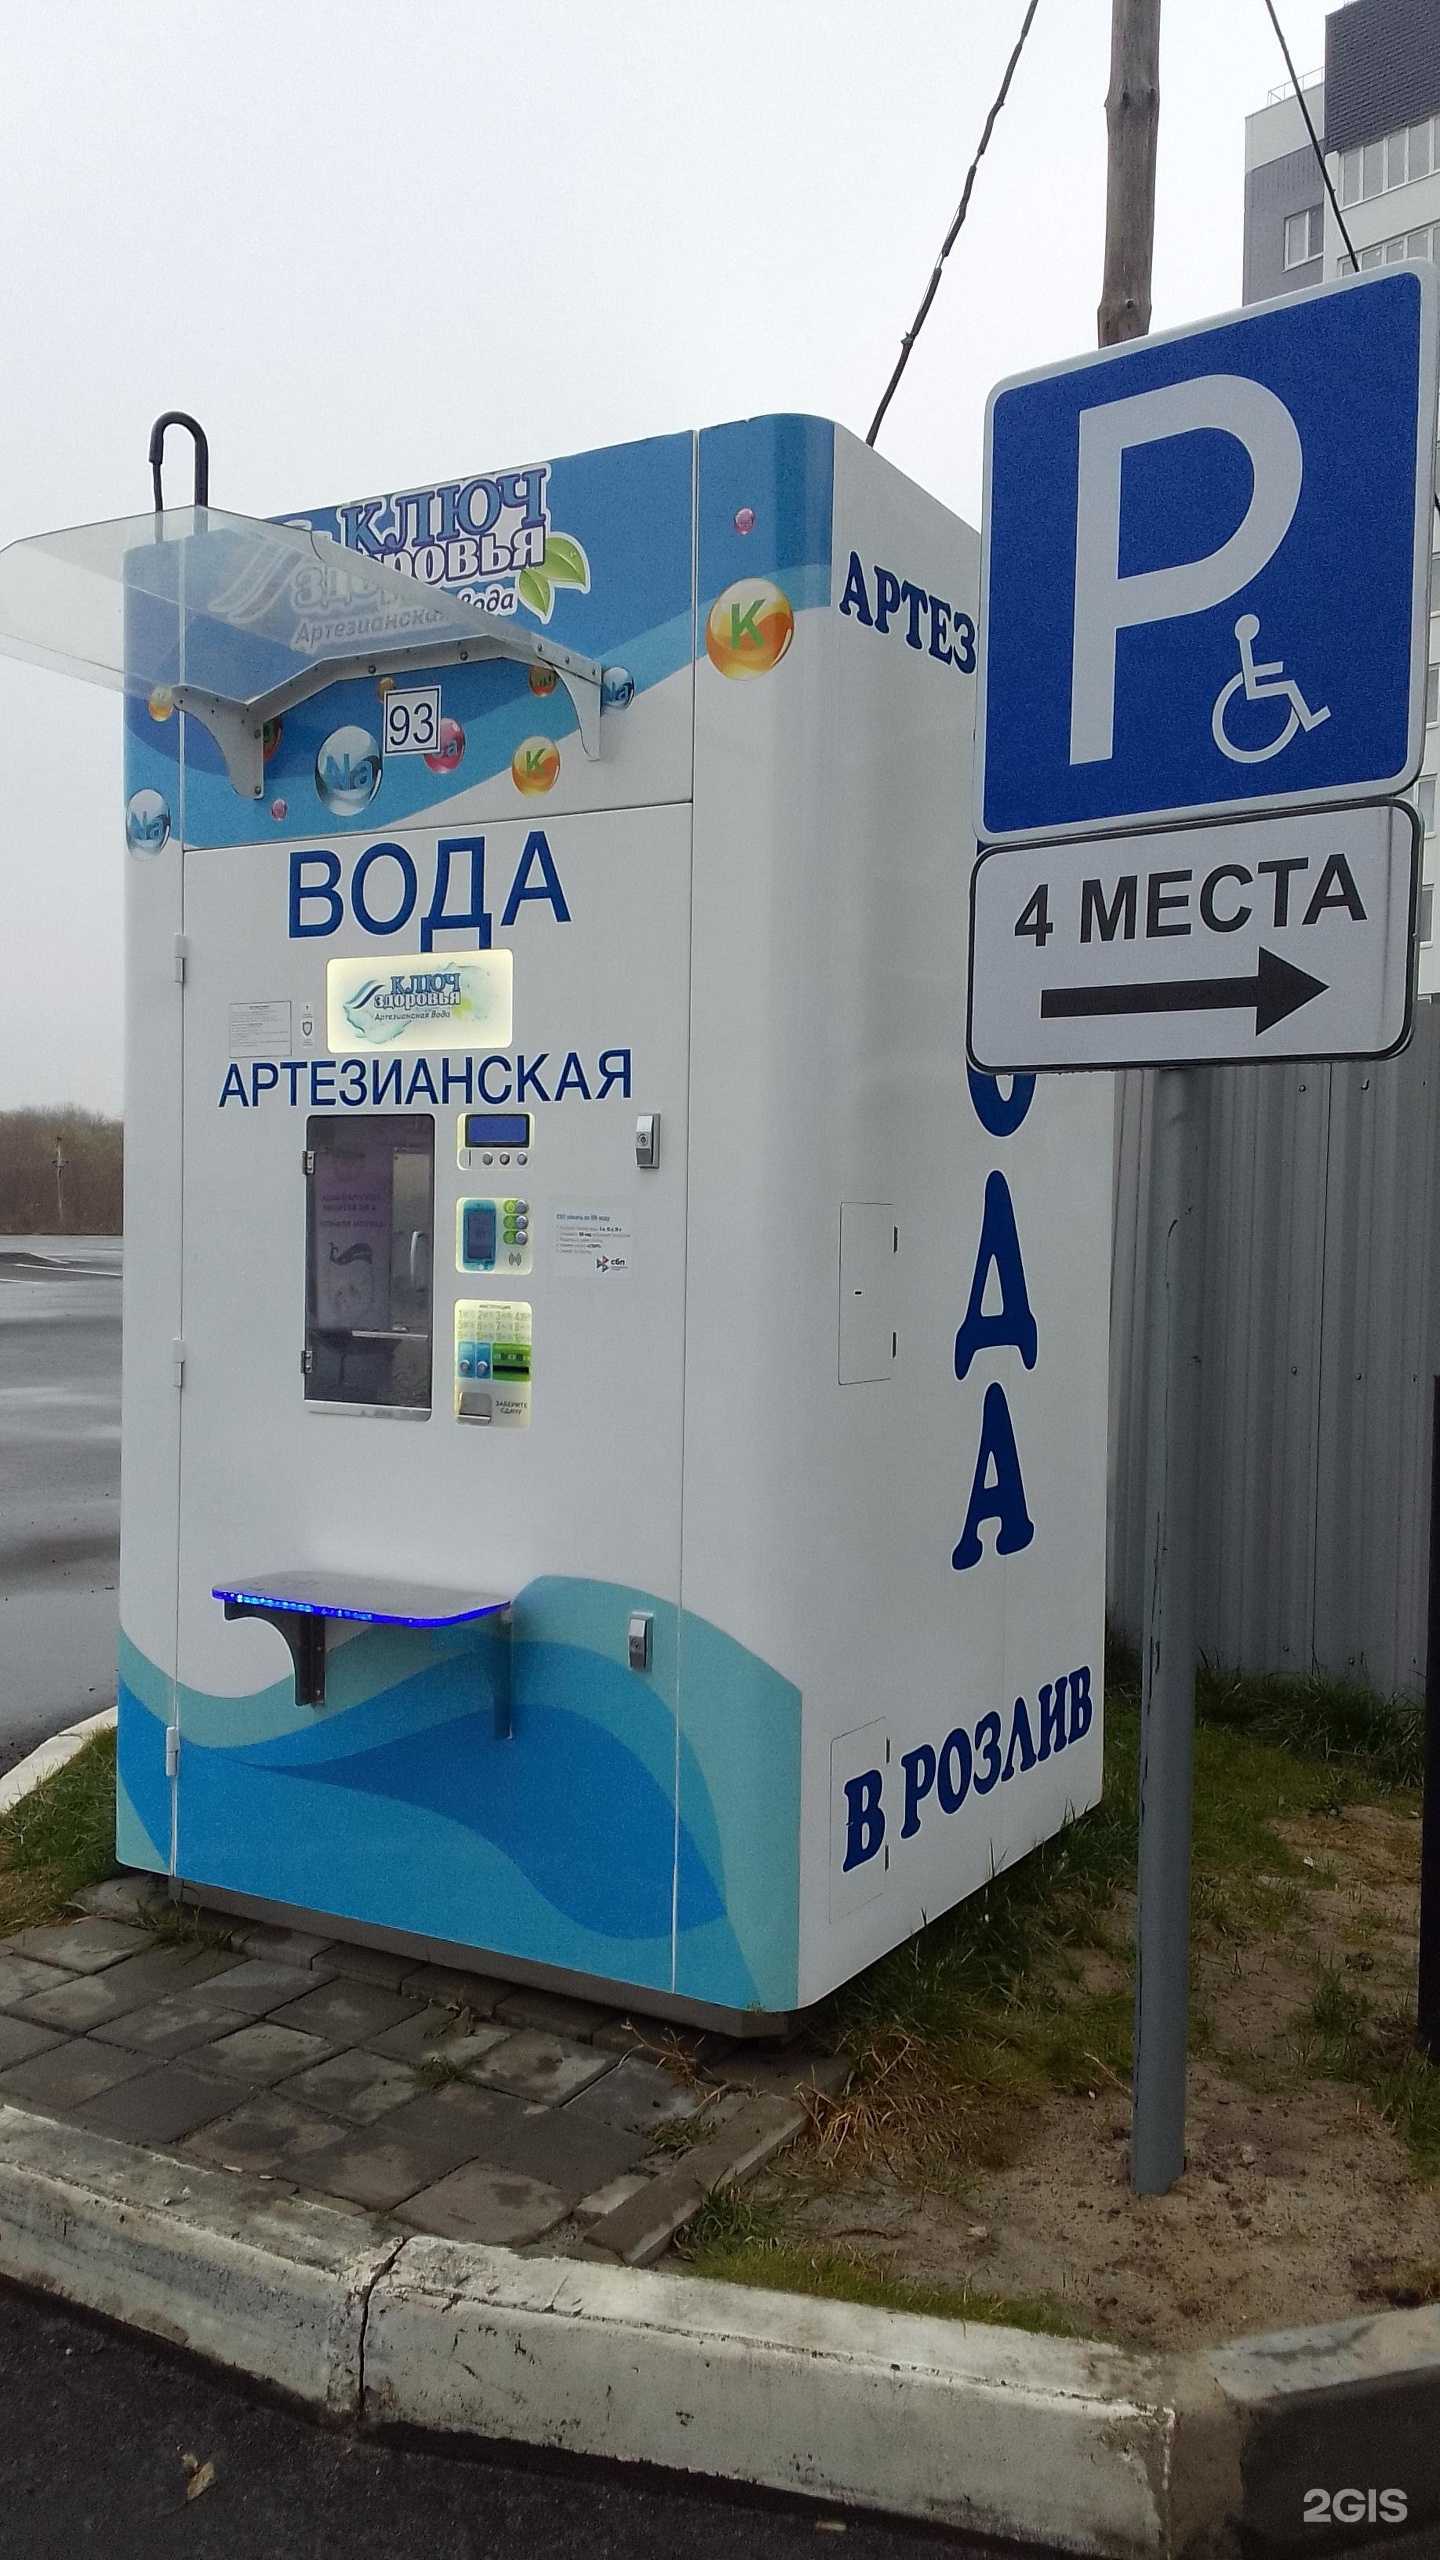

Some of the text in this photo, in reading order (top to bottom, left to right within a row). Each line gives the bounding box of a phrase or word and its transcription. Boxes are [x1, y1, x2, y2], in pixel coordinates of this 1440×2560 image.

[1069, 374, 1303, 766] P
[389, 702, 435, 746] 93
[288, 829, 572, 954] ВОДА
[1013, 853, 1368, 947] 4 МЕСТА
[217, 1048, 632, 1108] АРТЕЗИАНСКАЯ
[842, 1665, 1093, 1873] В РОЗЛИВ
